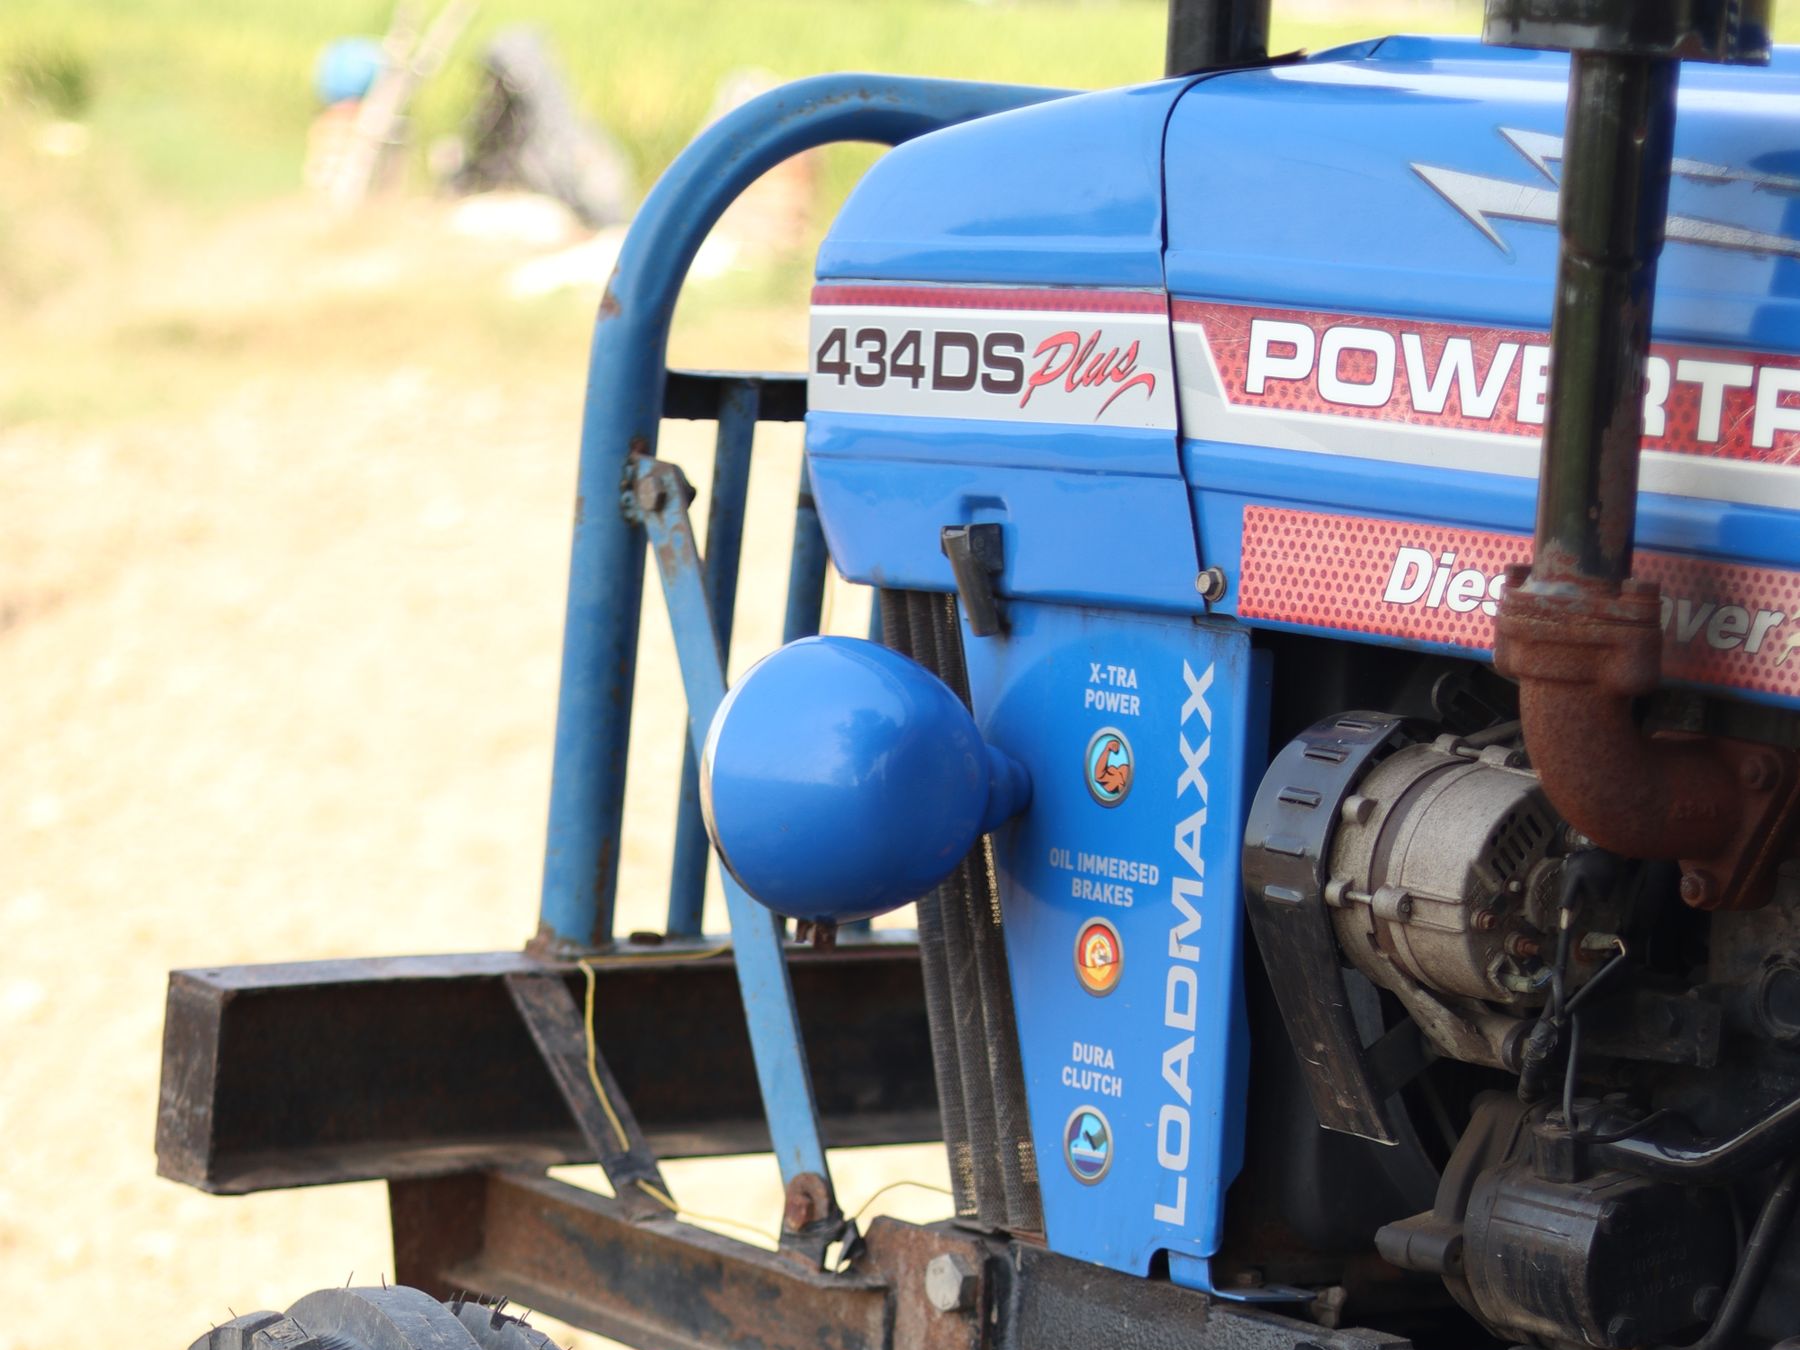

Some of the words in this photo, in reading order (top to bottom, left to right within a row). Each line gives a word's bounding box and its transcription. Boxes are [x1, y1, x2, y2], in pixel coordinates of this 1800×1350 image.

[816, 326, 1026, 395] 434DS
[1019, 328, 1156, 422] Plus
[1088, 662, 1138, 690] X-TRA
[1084, 688, 1141, 717] POWER
[1050, 847, 1074, 871] OIL
[1077, 851, 1160, 886] IMMERSED
[1071, 877, 1134, 908] BRAKES
[1154, 658, 1215, 1226] LOADMAXX
[1072, 1041, 1115, 1070] DURA
[1061, 1066, 1122, 1098] CLUTCH
